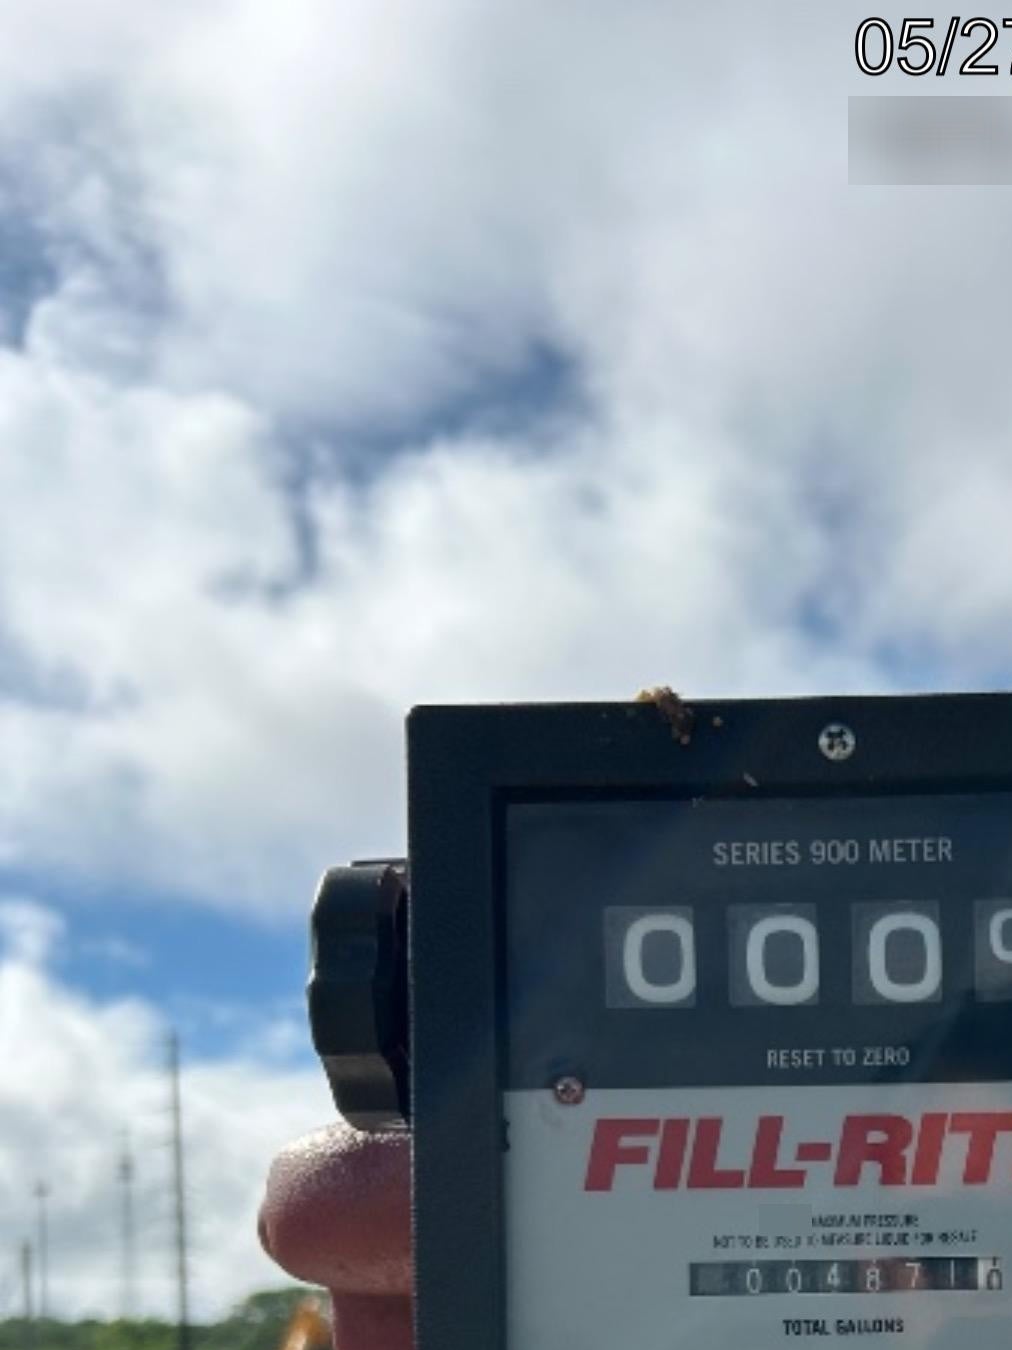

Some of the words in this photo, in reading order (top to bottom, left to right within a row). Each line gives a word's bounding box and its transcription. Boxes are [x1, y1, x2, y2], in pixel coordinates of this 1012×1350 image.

[713, 841, 800, 867] SERIES
[810, 840, 860, 865] 900
[869, 837, 954, 863] METER
[766, 1048, 825, 1070] RESET
[833, 1047, 857, 1068] TO
[862, 1046, 911, 1067] ZERO
[782, 1318, 830, 1337] TOTAL
[835, 1317, 905, 1336] GALLONS
